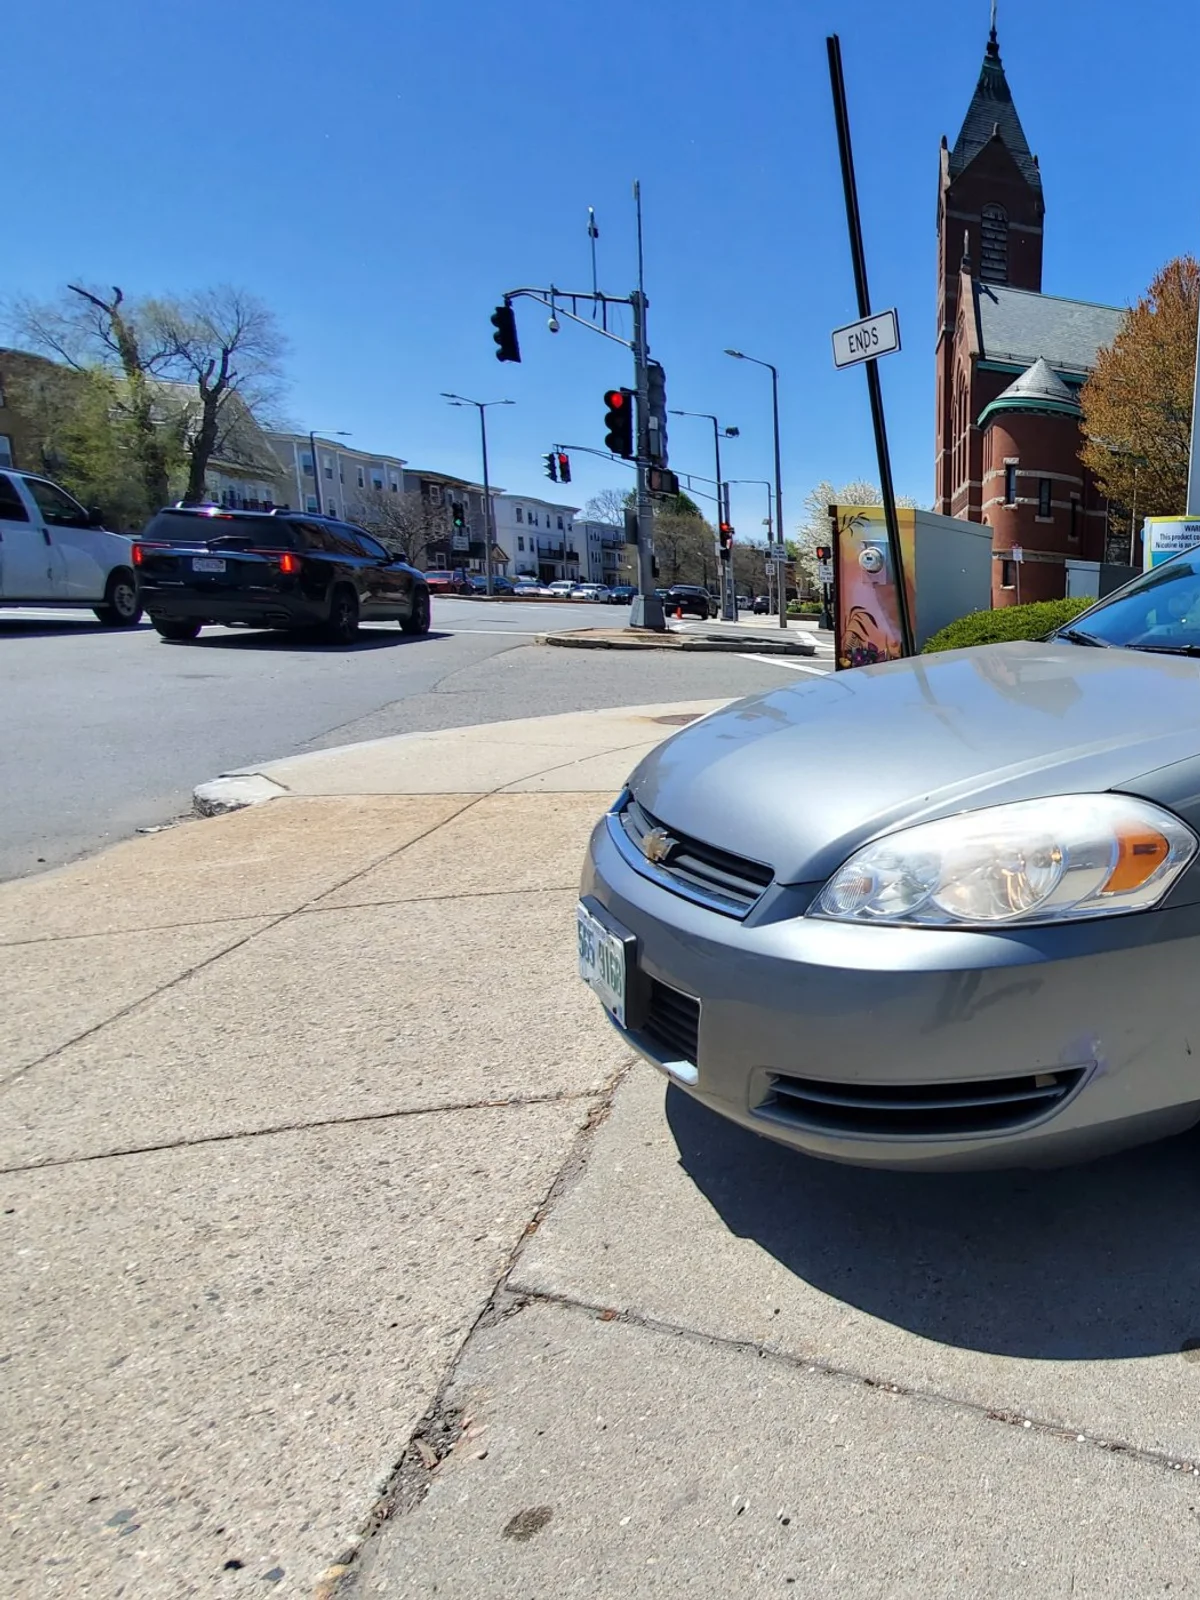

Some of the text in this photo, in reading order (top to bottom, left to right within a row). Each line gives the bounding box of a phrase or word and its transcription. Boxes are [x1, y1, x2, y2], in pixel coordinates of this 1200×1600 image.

[848, 327, 879, 353] ENDS
[1160, 533, 1171, 541] This
[1171, 533, 1192, 541] product
[1155, 541, 1178, 549] Nicotine
[1179, 541, 1184, 549] is
